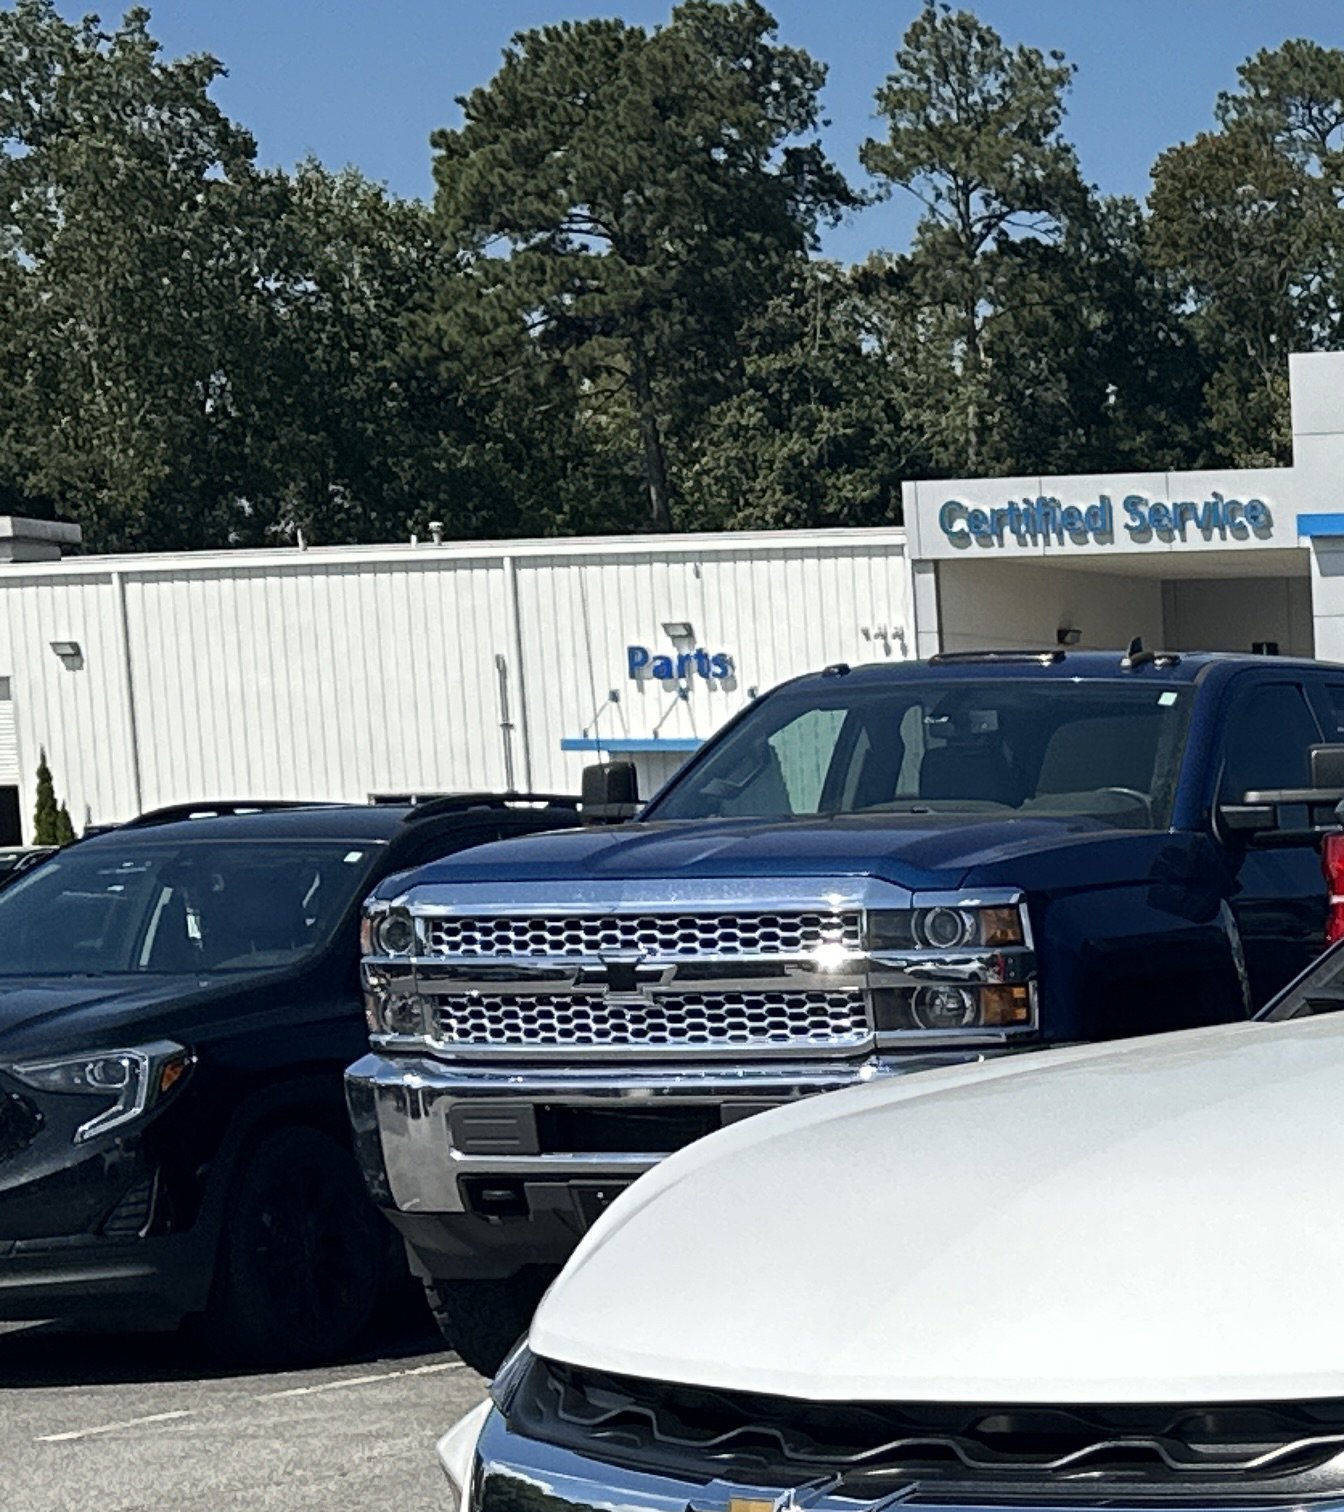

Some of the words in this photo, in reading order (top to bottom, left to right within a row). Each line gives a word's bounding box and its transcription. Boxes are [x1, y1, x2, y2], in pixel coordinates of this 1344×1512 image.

[938, 494, 1113, 545] Certified
[1123, 491, 1273, 541] Service
[626, 645, 733, 682] Parts
